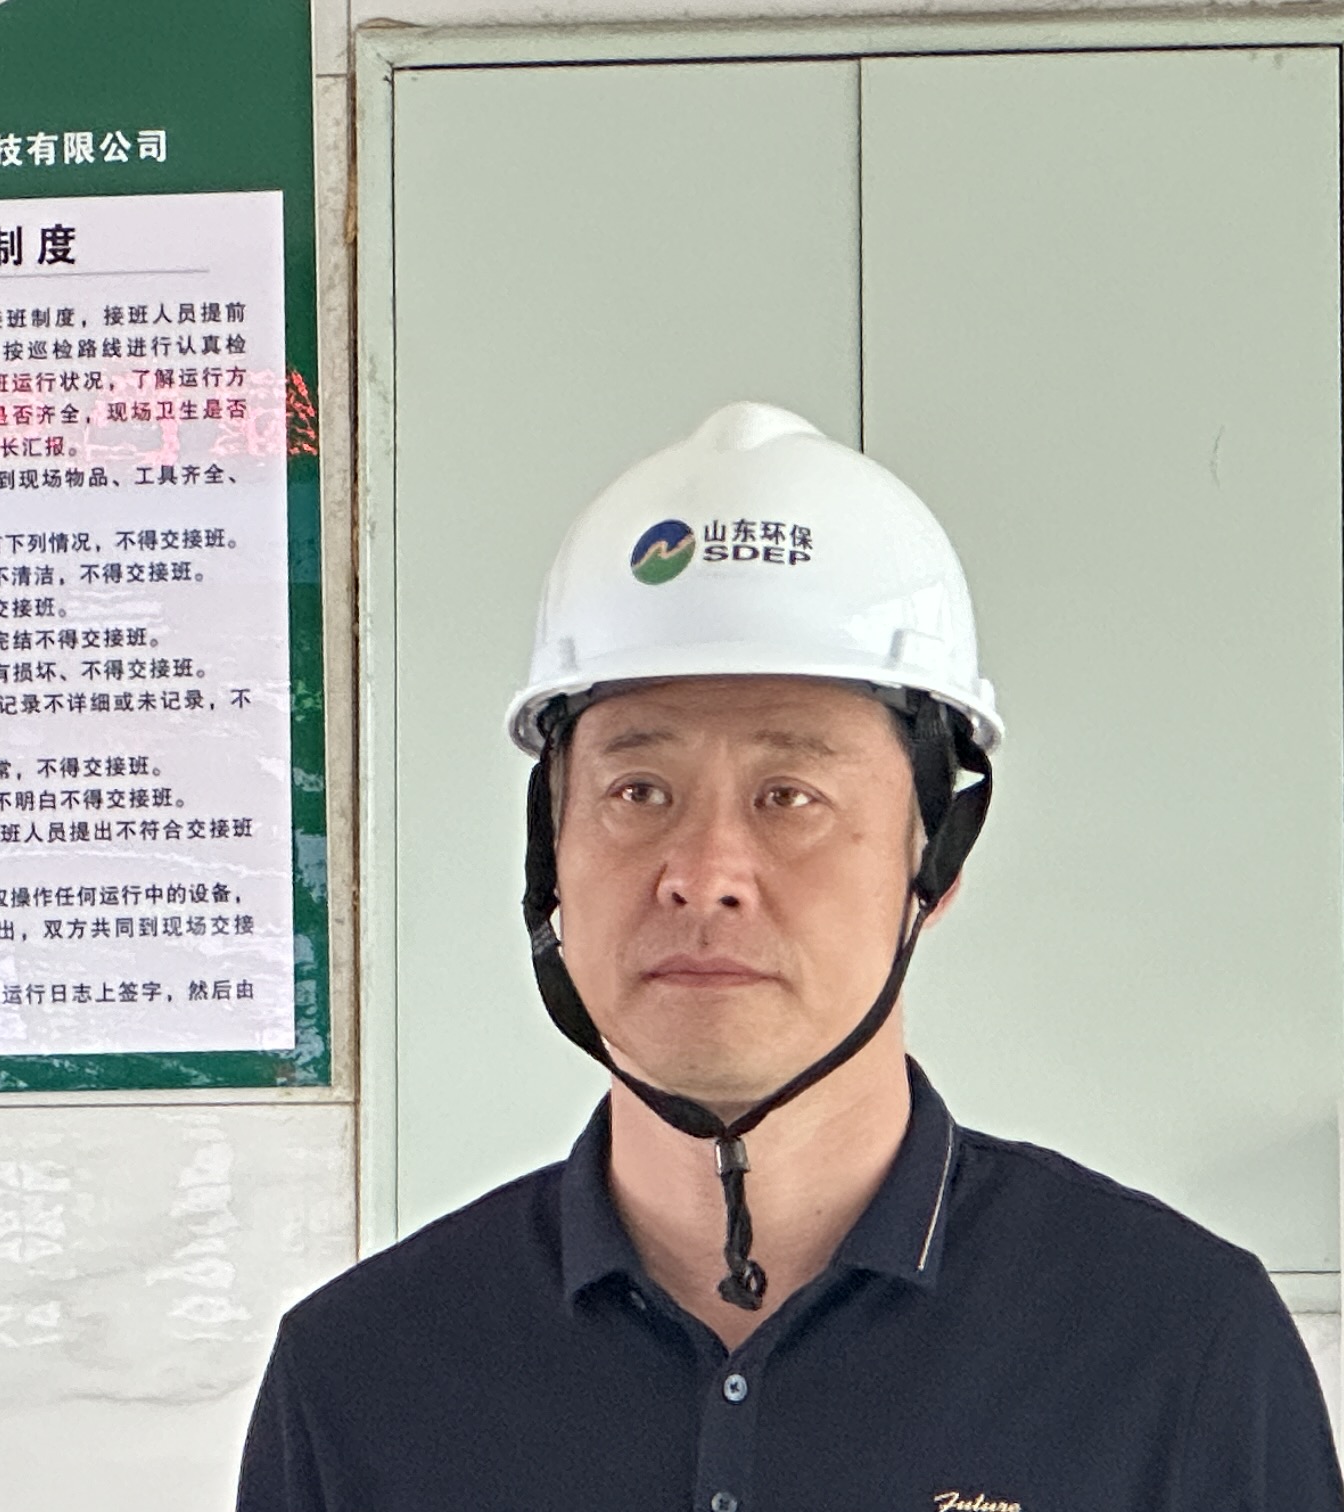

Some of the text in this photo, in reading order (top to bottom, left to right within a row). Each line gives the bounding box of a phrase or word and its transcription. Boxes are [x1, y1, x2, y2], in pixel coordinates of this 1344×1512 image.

[704, 519, 813, 550] 山东环保
[703, 545, 812, 566] SDEP
